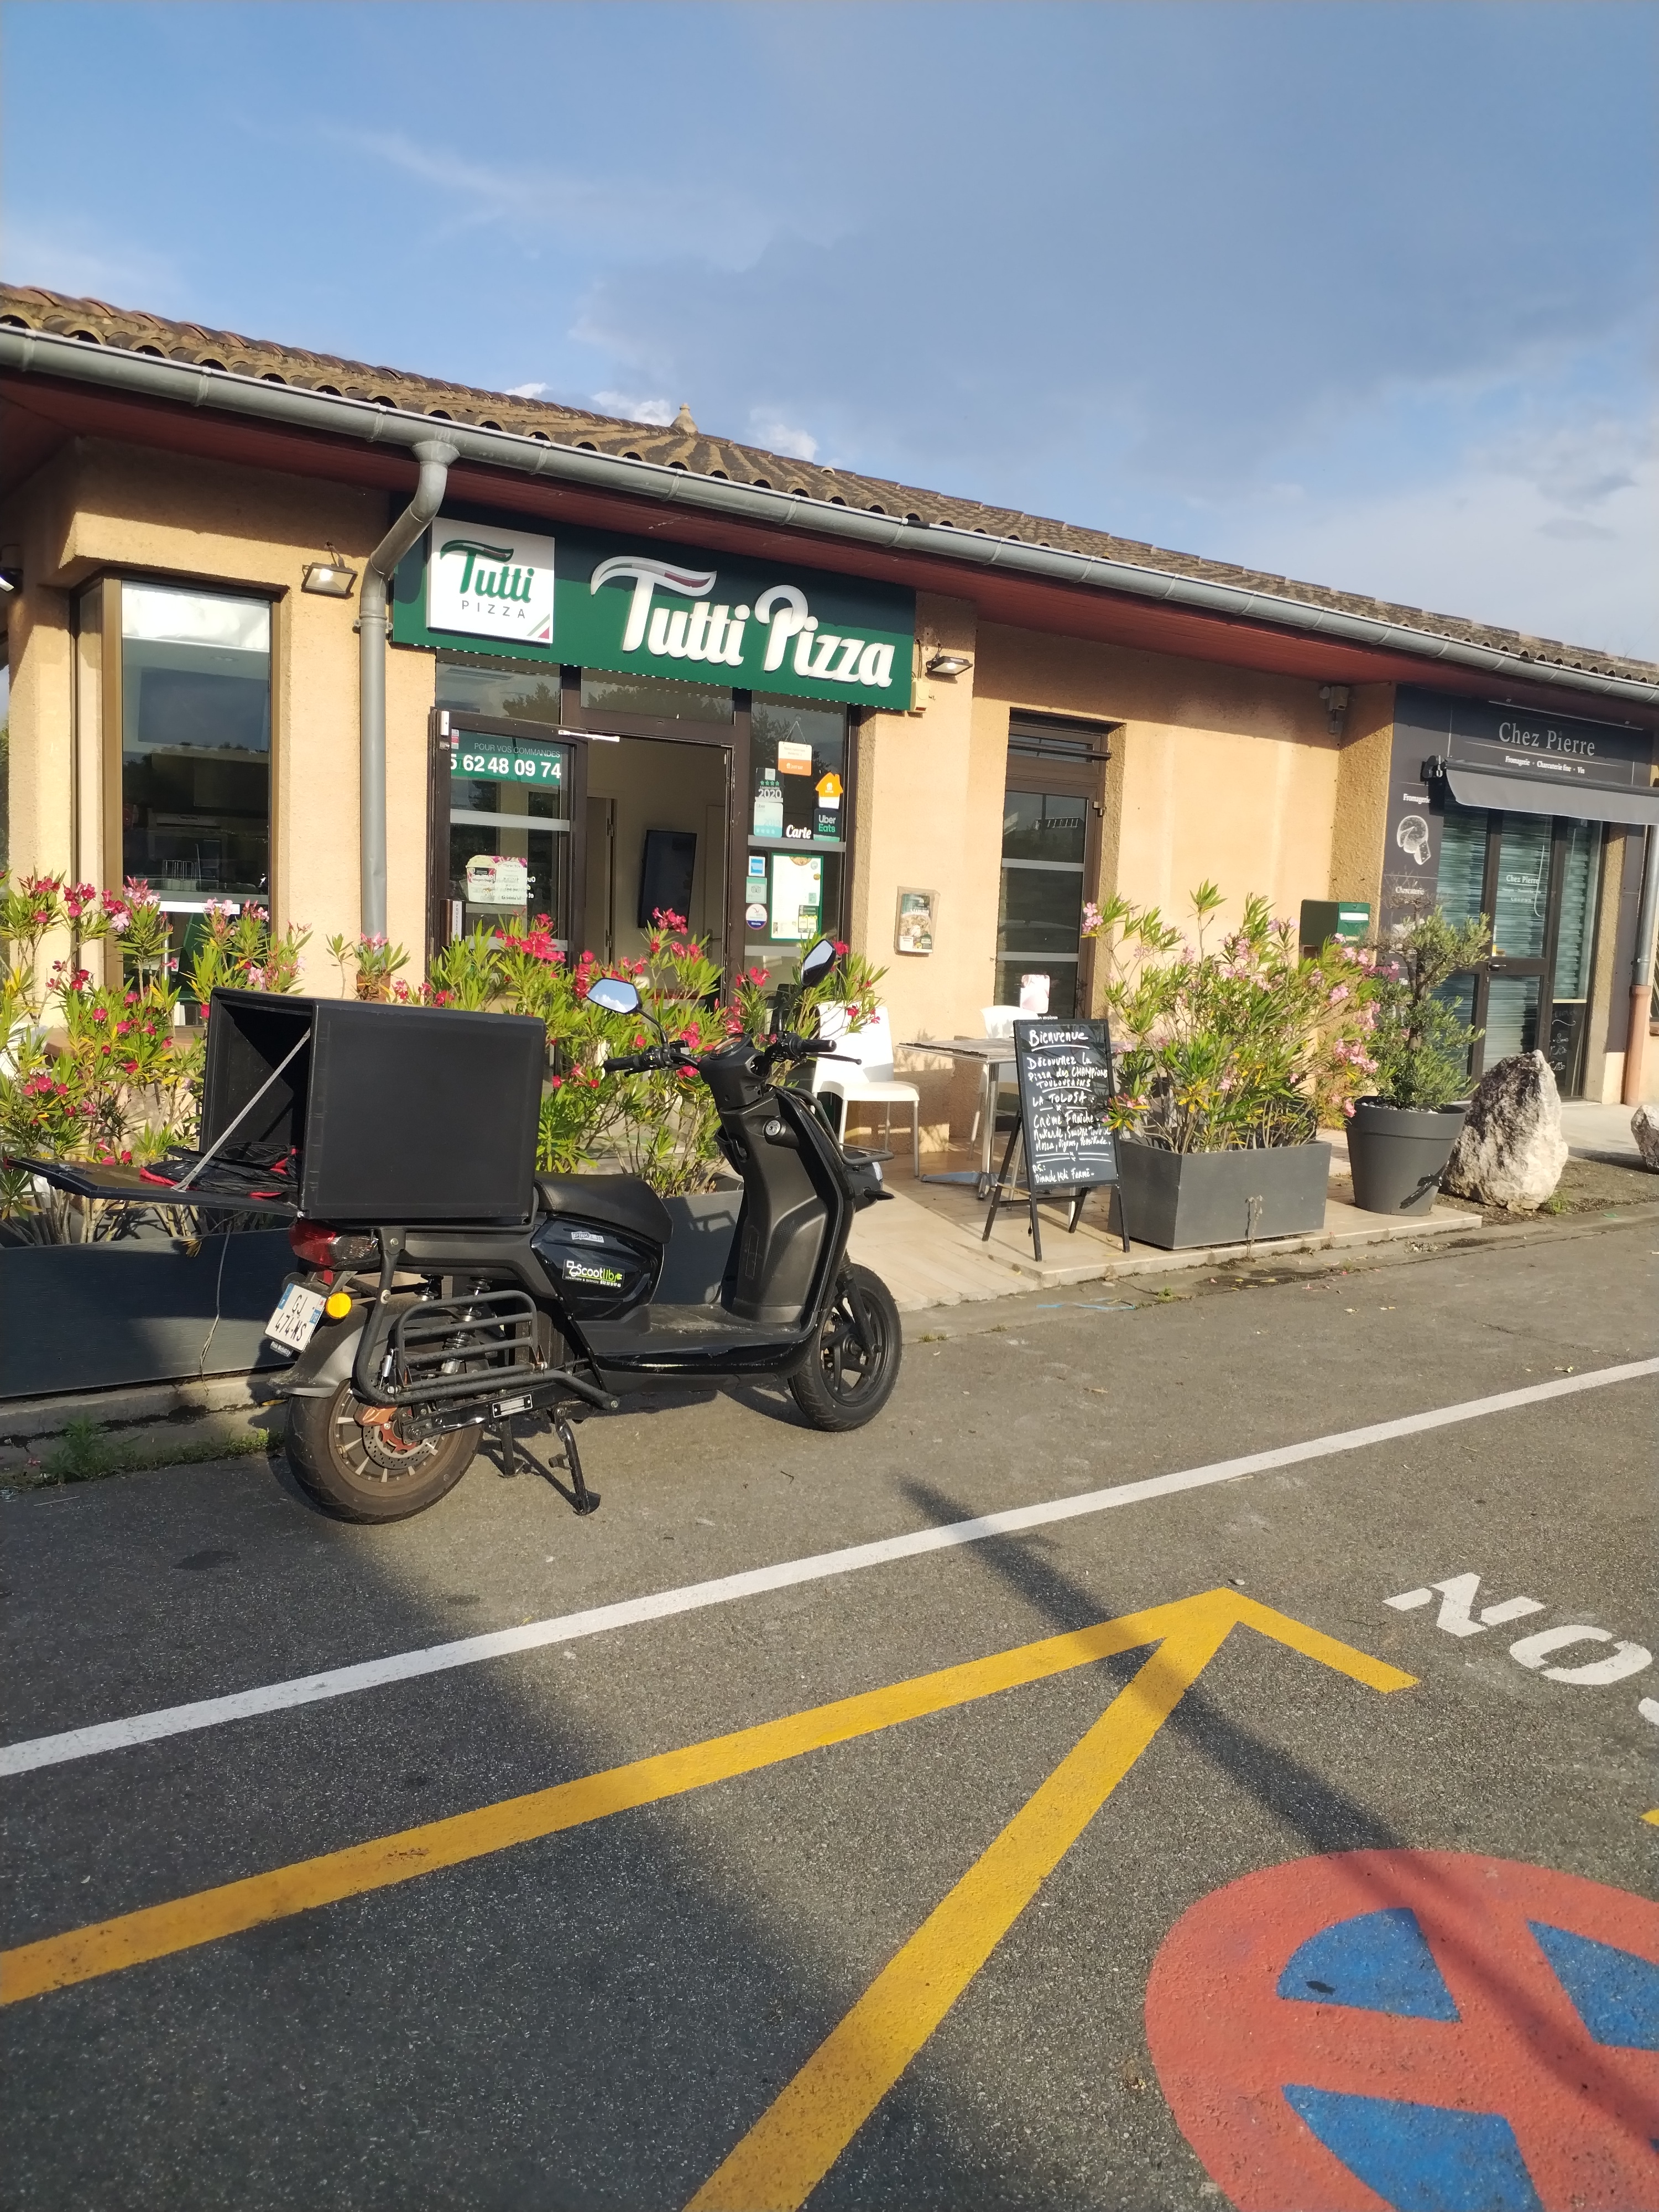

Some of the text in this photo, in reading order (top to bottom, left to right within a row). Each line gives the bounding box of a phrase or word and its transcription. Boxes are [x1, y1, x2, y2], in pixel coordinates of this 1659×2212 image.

[440, 540, 534, 604] Tutti
[461, 600, 527, 619] PIZZA
[590, 556, 896, 688] Tutti Pizza
[1499, 722, 1595, 756] Chez Pierre
[474, 743, 561, 758] POUR VOS COMMANDES
[463, 754, 485, 772] 62
[487, 757, 509, 774] 48
[514, 759, 536, 777] 09
[541, 761, 562, 779] 74
[1505, 755, 1531, 767] Fromagerie
[1536, 760, 1563, 771] Charcuterie
[758, 789, 782, 799] 2020
[1403, 793, 1431, 805] Fromagerie
[818, 814, 836, 825] Uber
[786, 824, 812, 839] Carte
[818, 823, 836, 832] Eats
[1506, 874, 1539, 884] Chez Pierre
[1029, 1029, 1089, 1047] Bienvenue
[1056, 1067, 1069, 1078] des
[1032, 1095, 1044, 1107] LA
[576, 1263, 615, 1281] Scootlib
[291, 1294, 308, 1315] GJ
